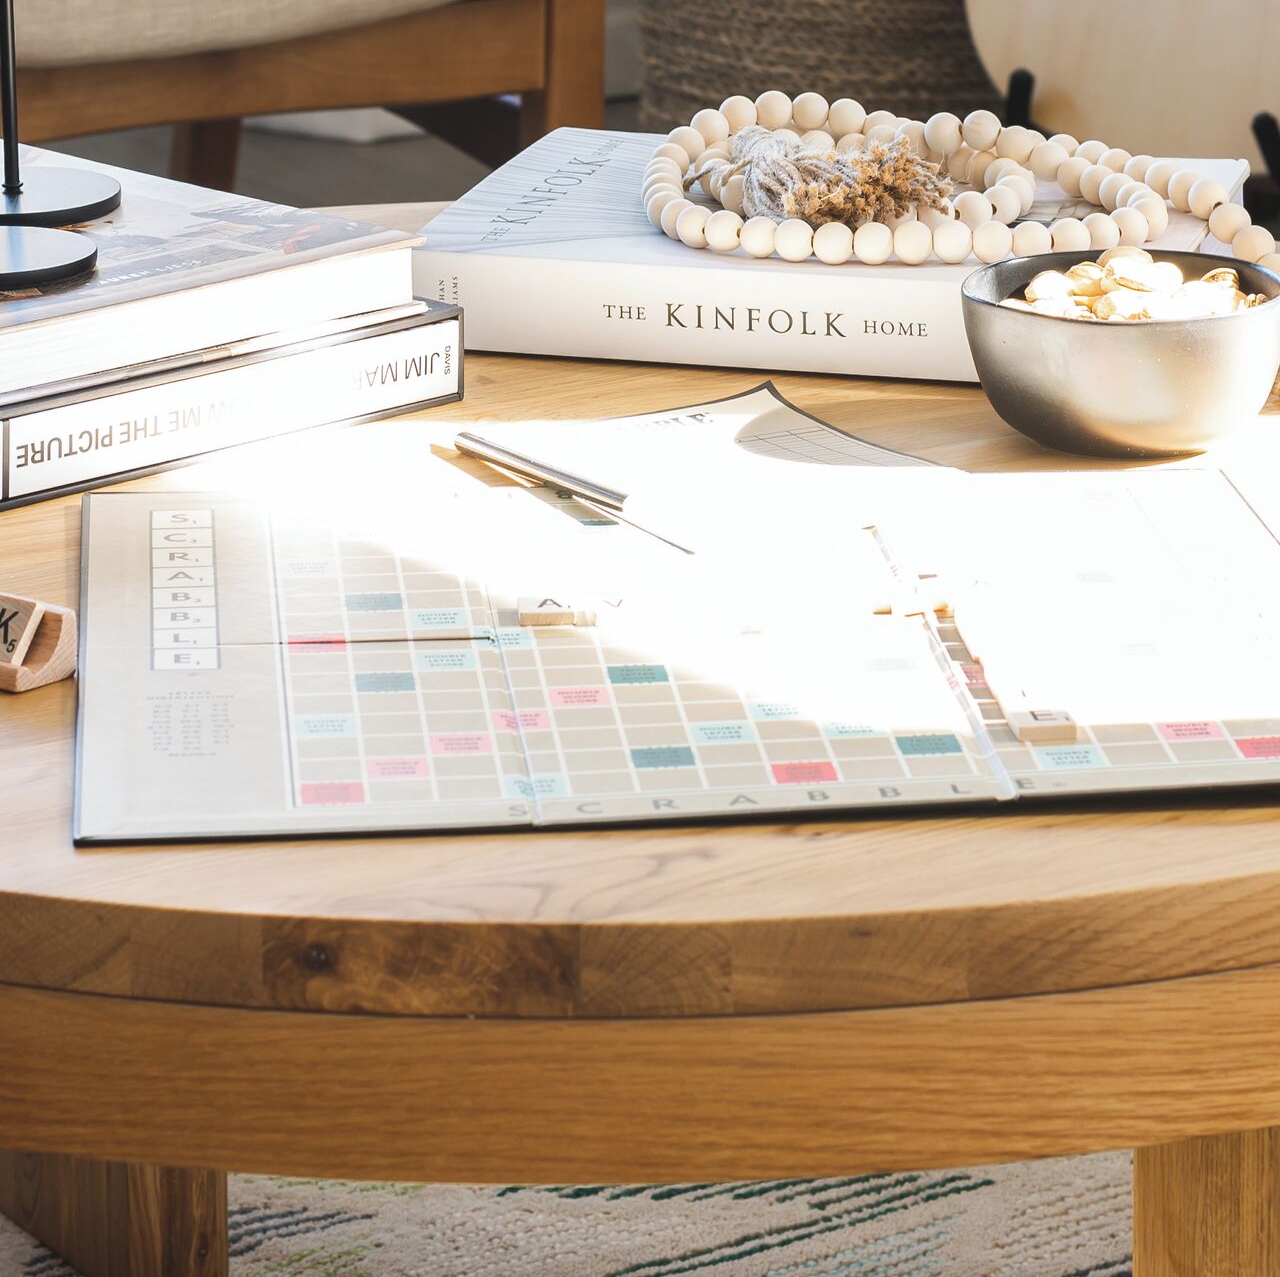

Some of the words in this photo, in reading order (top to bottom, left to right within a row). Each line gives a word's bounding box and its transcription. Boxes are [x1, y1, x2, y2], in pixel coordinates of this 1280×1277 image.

[490, 157, 611, 225] KINFOLK
[480, 227, 511, 242] THE
[603, 303, 647, 321] THE
[665, 303, 848, 338] KINFOLK
[863, 319, 930, 338] HOME
[404, 352, 441, 380] JIM
[443, 345, 452, 376] DAVIS
[120, 416, 163, 444] THE
[168, 403, 207, 433] ME
[15, 422, 114, 469] PICTURE
